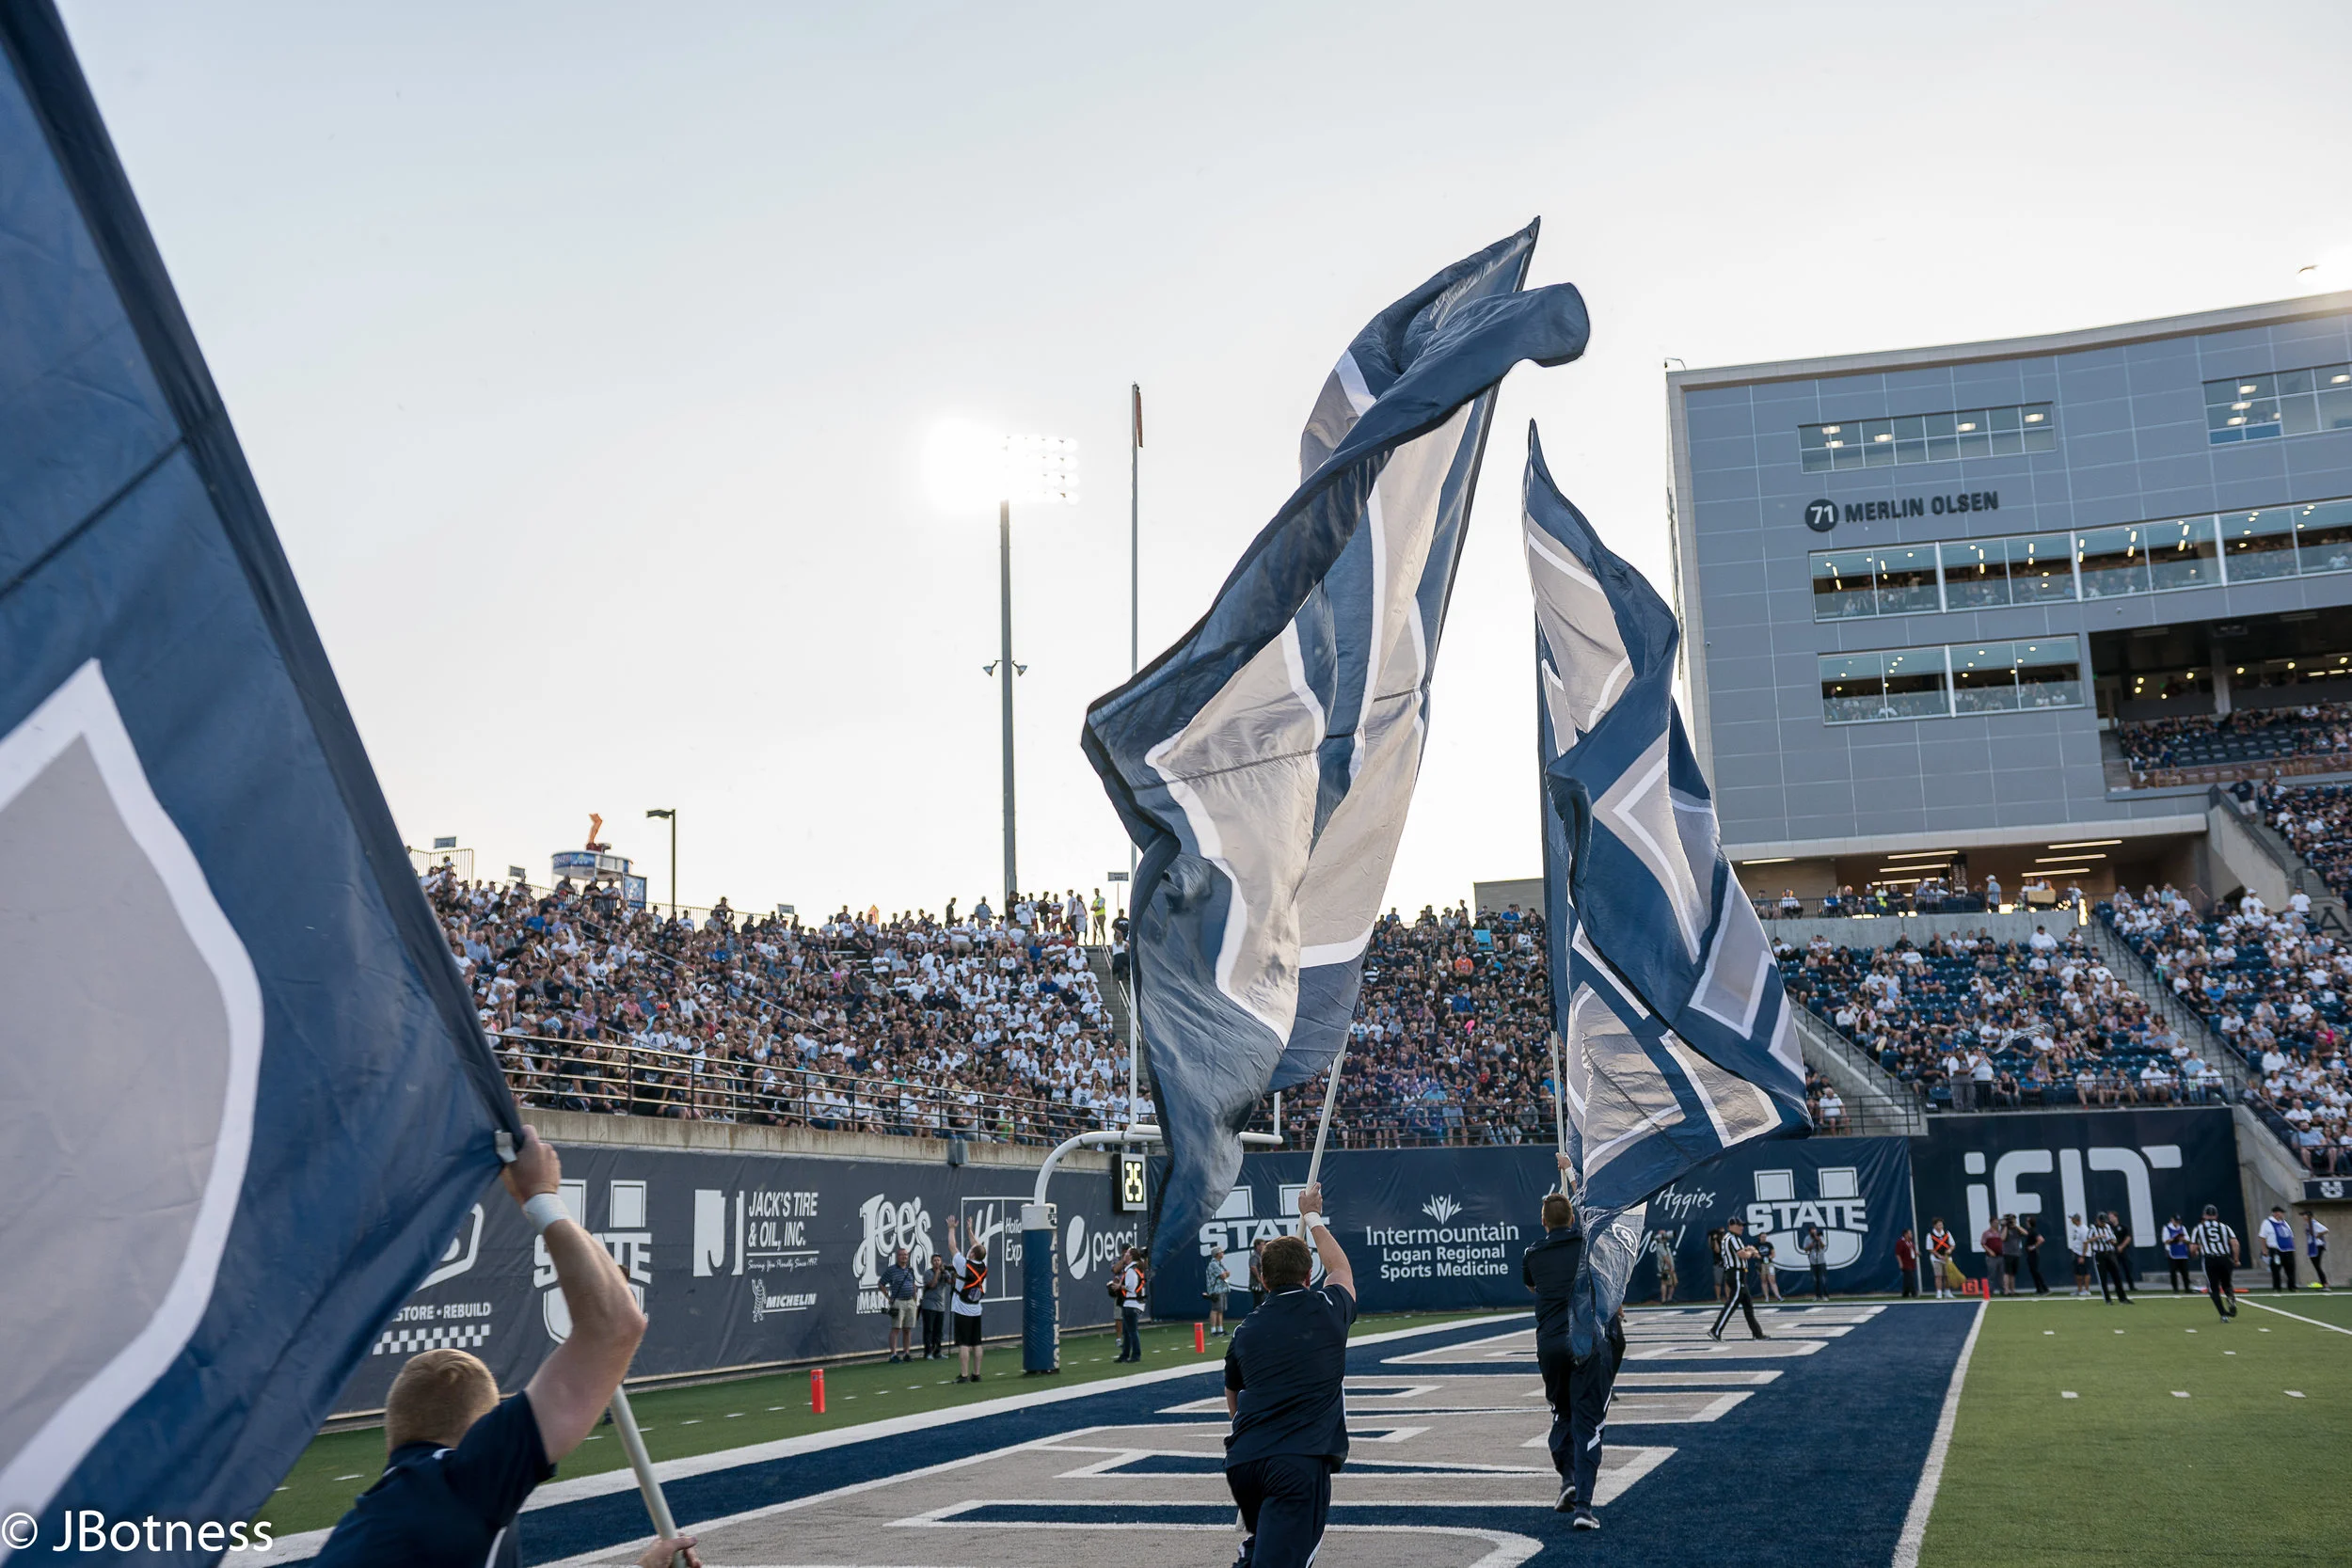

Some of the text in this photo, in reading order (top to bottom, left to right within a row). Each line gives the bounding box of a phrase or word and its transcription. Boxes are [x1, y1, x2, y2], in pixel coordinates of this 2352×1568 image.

[1810, 490, 1999, 524] 71 MERLIN OLSEN
[1125, 1162, 1143, 1202] 25
[749, 1191, 818, 1217] JACK'S TIRE
[1655, 1183, 1717, 1220] Aggies
[1746, 1198, 1868, 1237] STATE
[748, 1221, 806, 1251] & OIL, INC.
[1366, 1221, 1519, 1245] Intermountain
[2206, 1227, 2220, 1243] S
[532, 1232, 652, 1289] STE
[1383, 1243, 1505, 1264] Logan Regional
[1380, 1260, 1509, 1282] Sports Medicine
[392, 1302, 492, 1323] STORE REBUILD
[766, 1293, 817, 1308] MICHELIN
